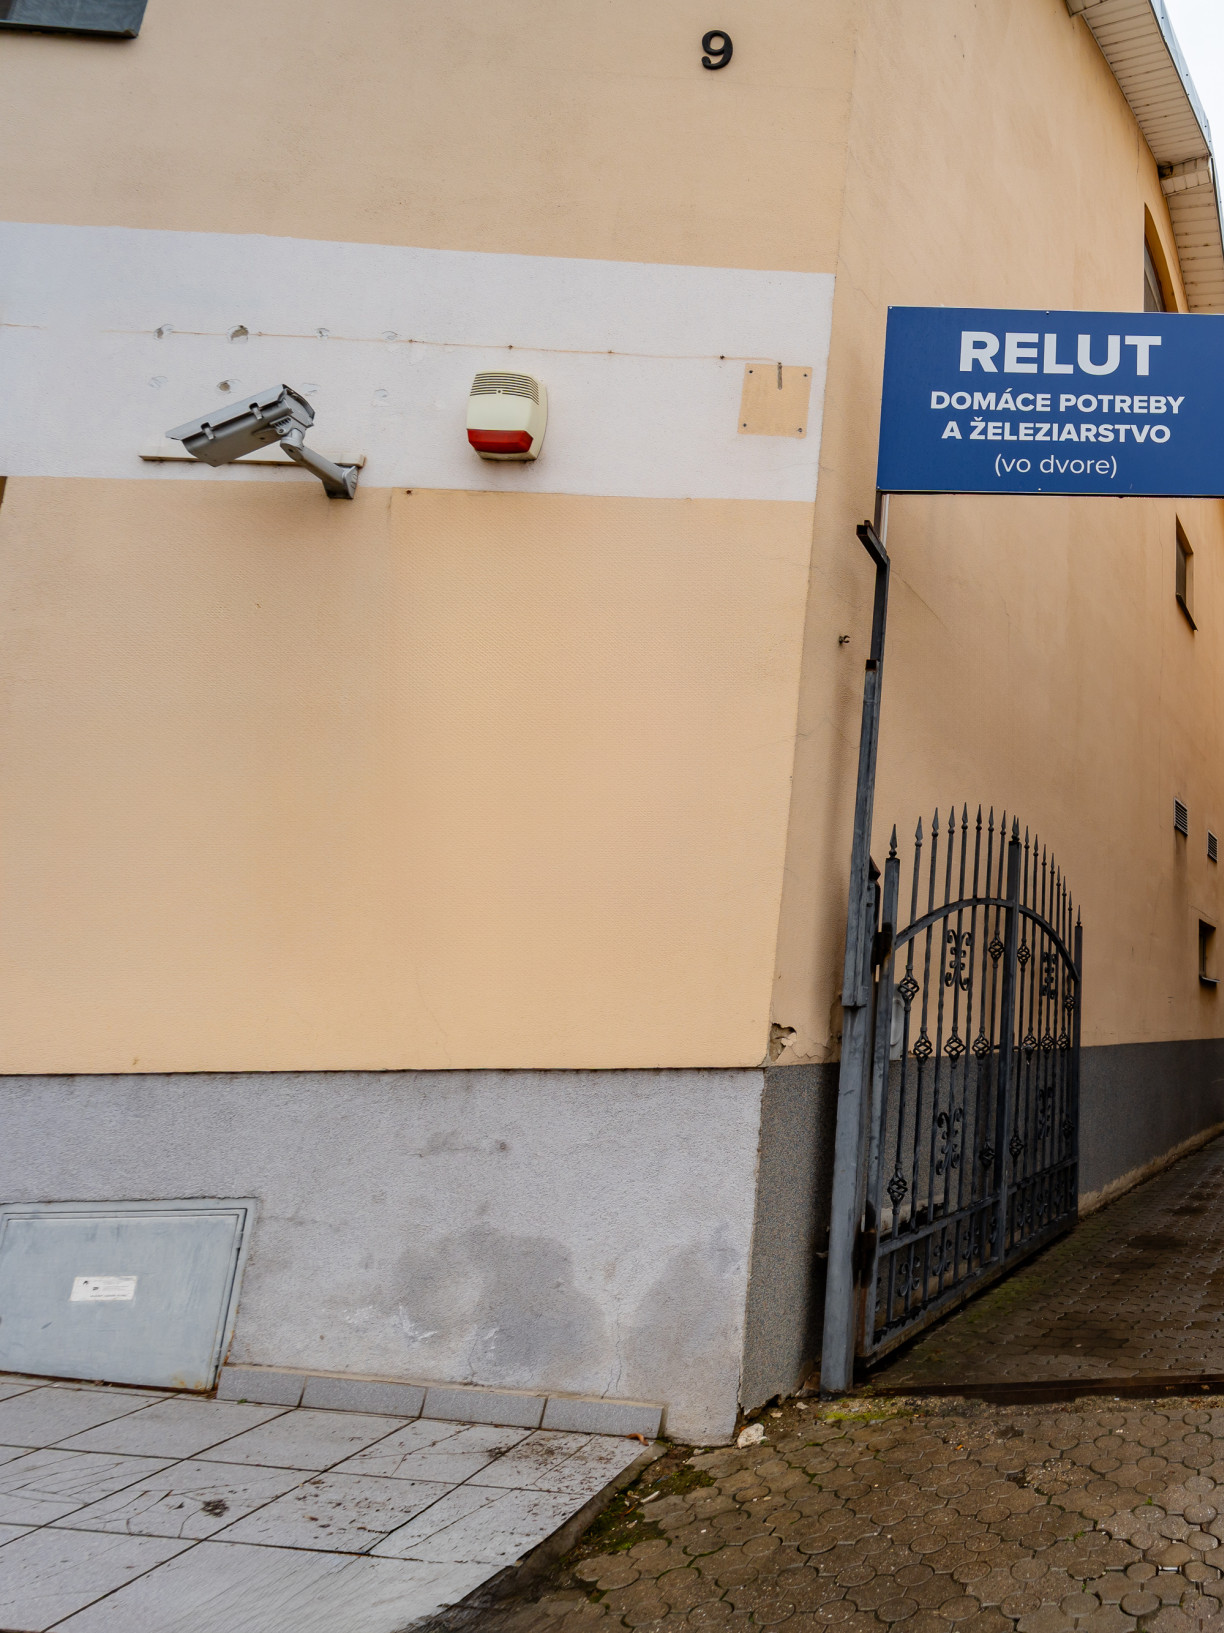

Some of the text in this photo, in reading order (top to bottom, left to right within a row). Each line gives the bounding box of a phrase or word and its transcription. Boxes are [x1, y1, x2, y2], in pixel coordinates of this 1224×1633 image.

[701, 30, 734, 70] 9
[959, 330, 1162, 376] RELUT
[930, 388, 1185, 414] DOMÁCE POTREBY
[941, 416, 1171, 444] A ŽELEZIARSTVO
[994, 453, 1118, 479] (vo dvore)
